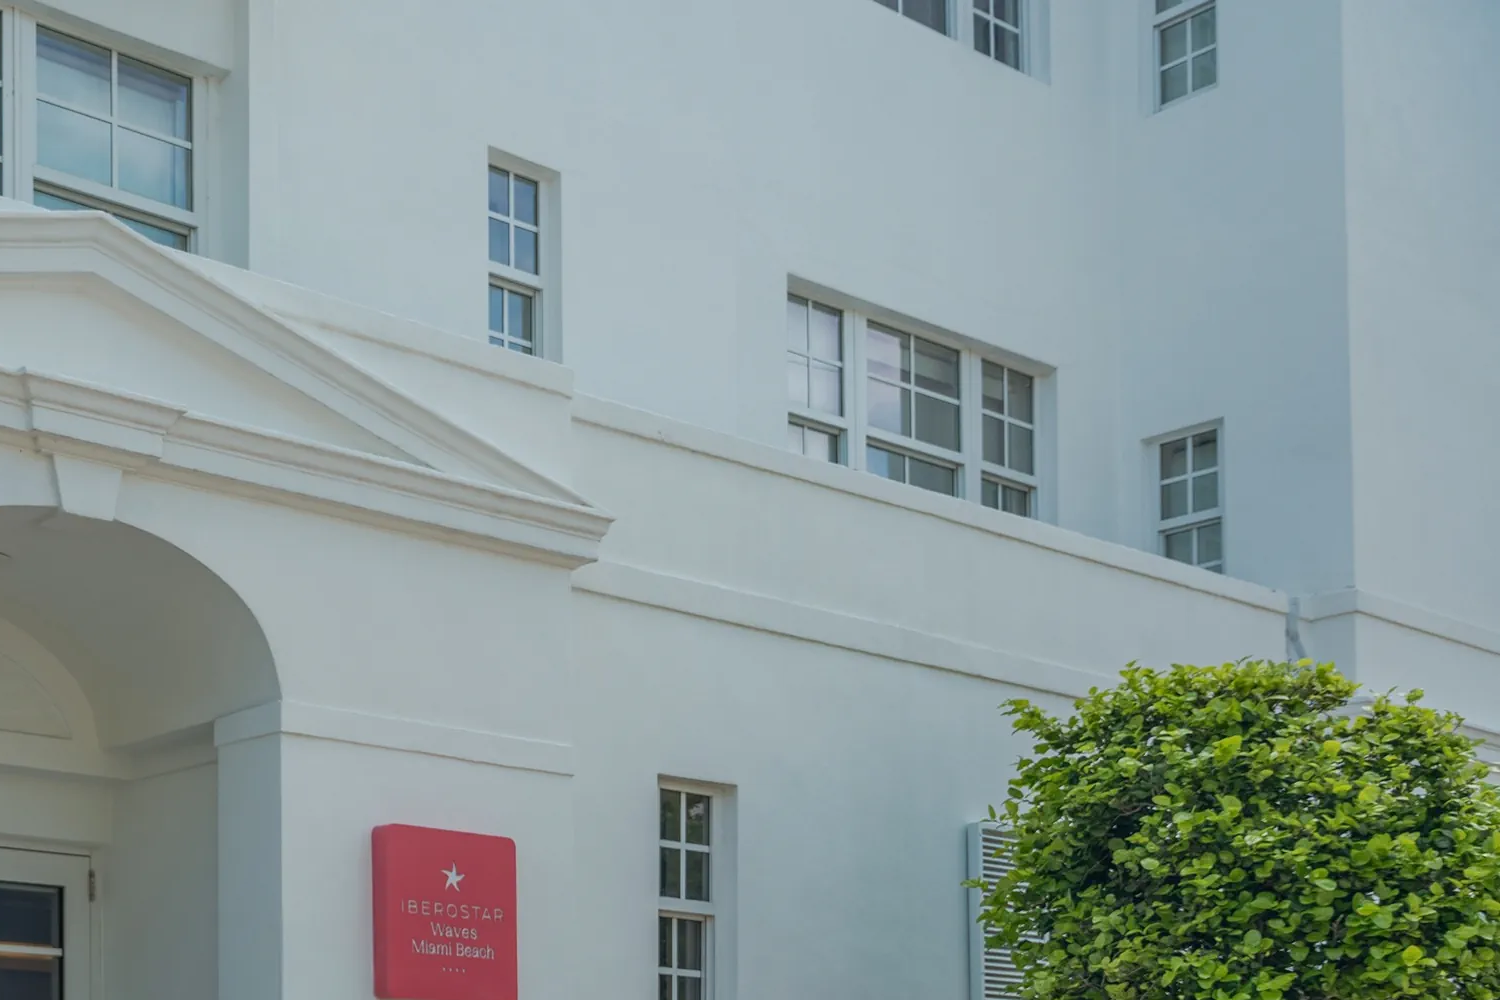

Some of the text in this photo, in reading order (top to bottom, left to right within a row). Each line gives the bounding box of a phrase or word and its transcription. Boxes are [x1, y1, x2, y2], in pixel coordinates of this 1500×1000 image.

[401, 899, 504, 922] IBEROSTAR
[430, 922, 477, 939] Waves
[412, 939, 495, 960] Miami Beach
